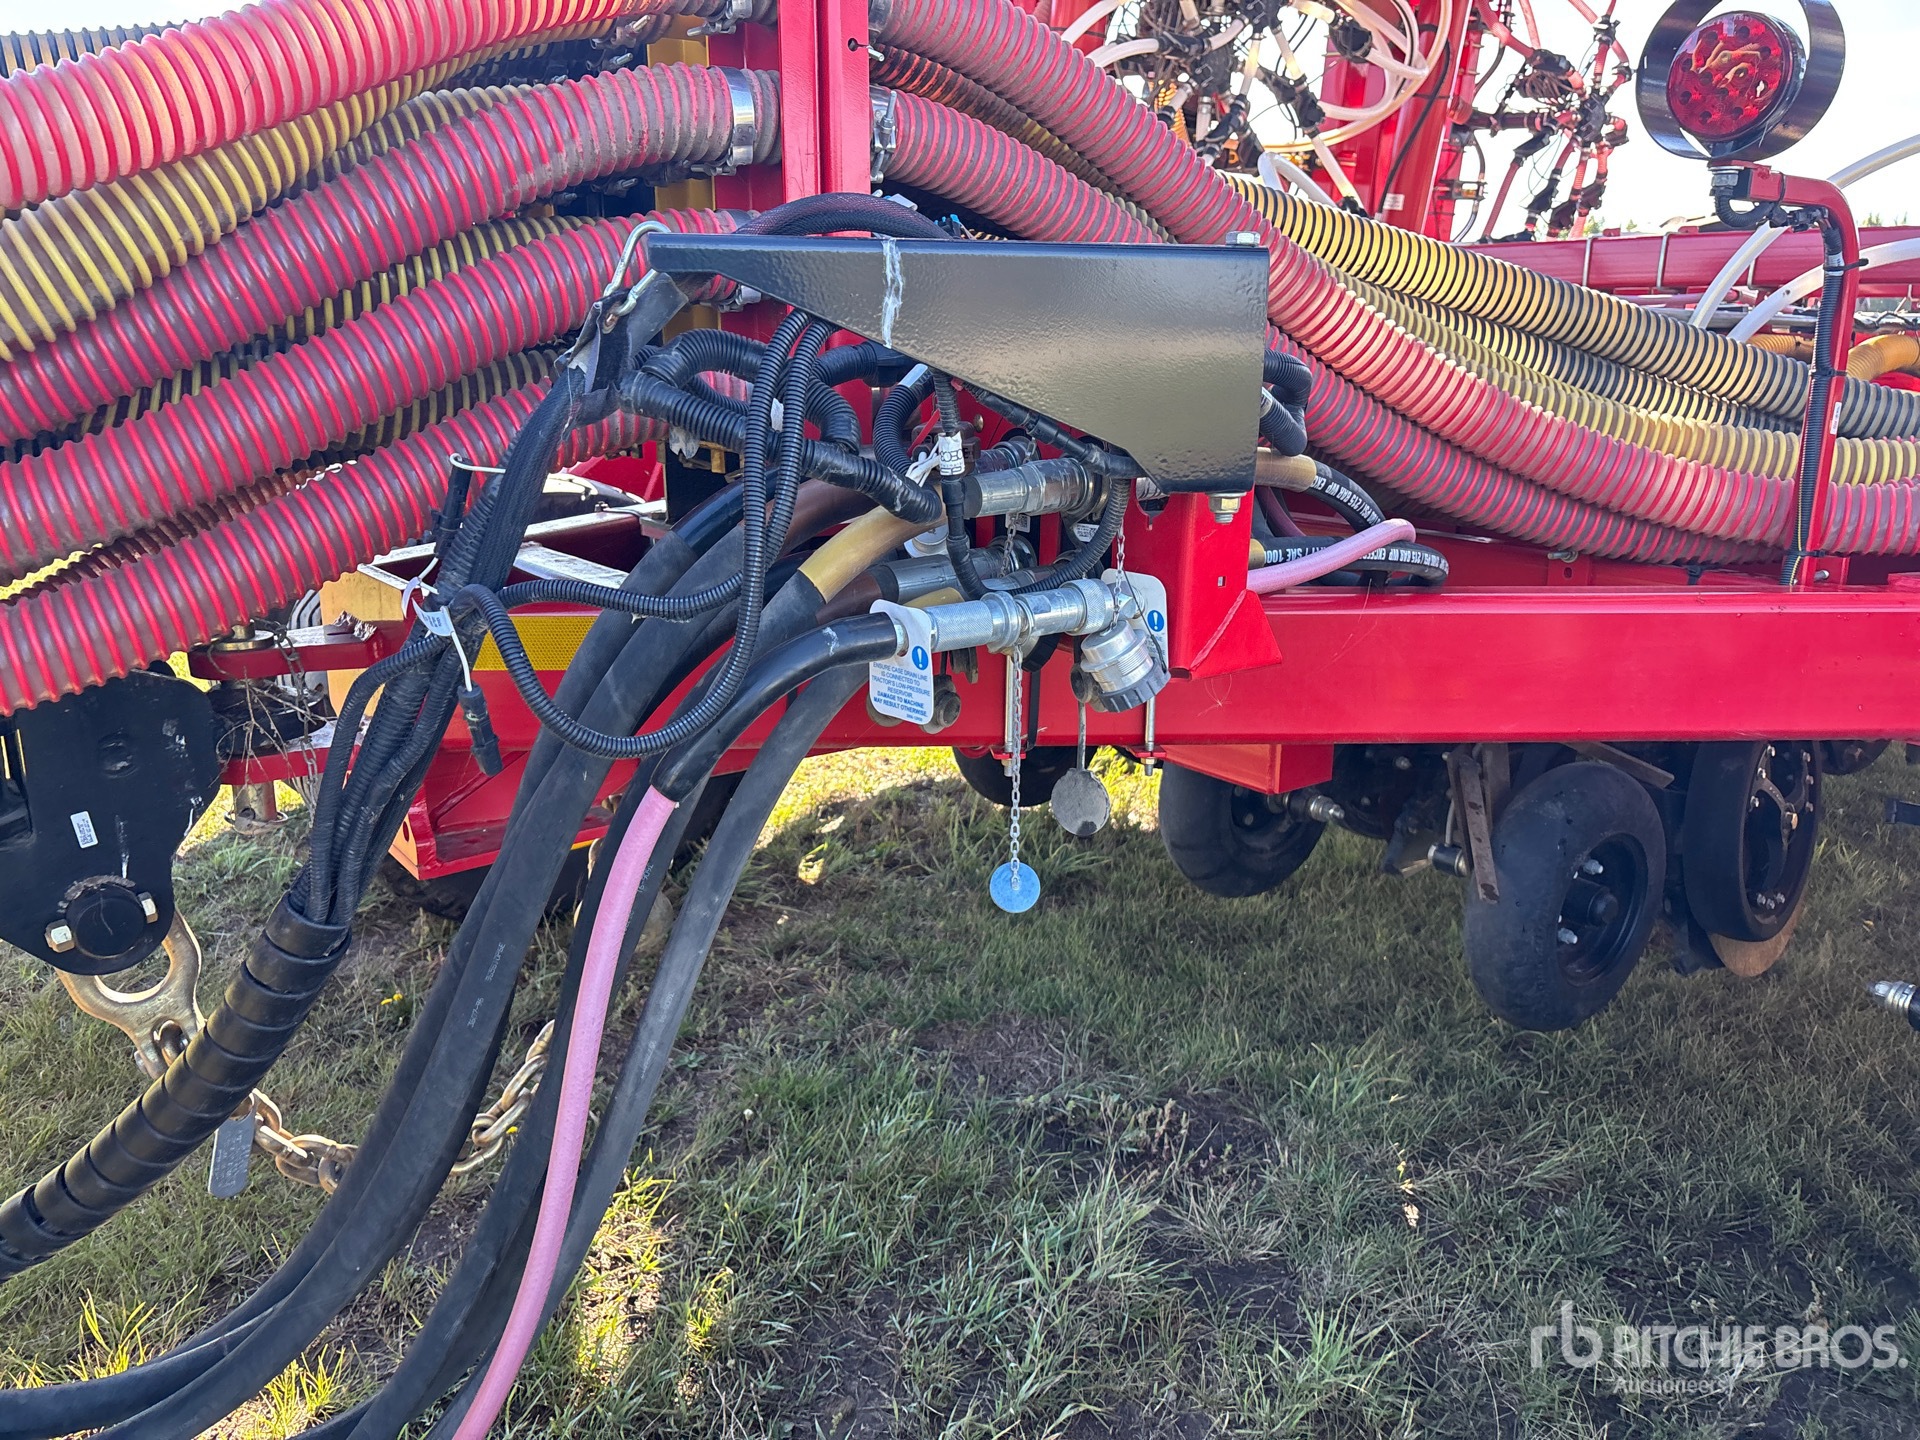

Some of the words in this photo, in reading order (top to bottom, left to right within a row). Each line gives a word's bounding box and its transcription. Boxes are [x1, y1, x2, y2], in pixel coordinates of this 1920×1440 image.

[1325, 482, 1340, 497] WP
[1336, 487, 1353, 503] BAR
[1348, 494, 1363, 510] 215
[1286, 547, 1303, 562] SAE
[1388, 548, 1399, 561] WP
[1400, 549, 1411, 562] BAR
[1412, 550, 1421, 564] 215
[873, 662, 891, 672] ENSURE
[891, 666, 904, 675] CASE
[904, 670, 918, 678] DRAIN
[872, 675, 895, 686] TRACTOR'S
[896, 682, 930, 696] LOW-PRESSURE
[886, 672, 914, 685] CONNECTED
[874, 696, 882, 704] MAY
[883, 699, 900, 709] RESULT
[877, 690, 896, 701] DAMAGE
[904, 698, 924, 709] MACHINE
